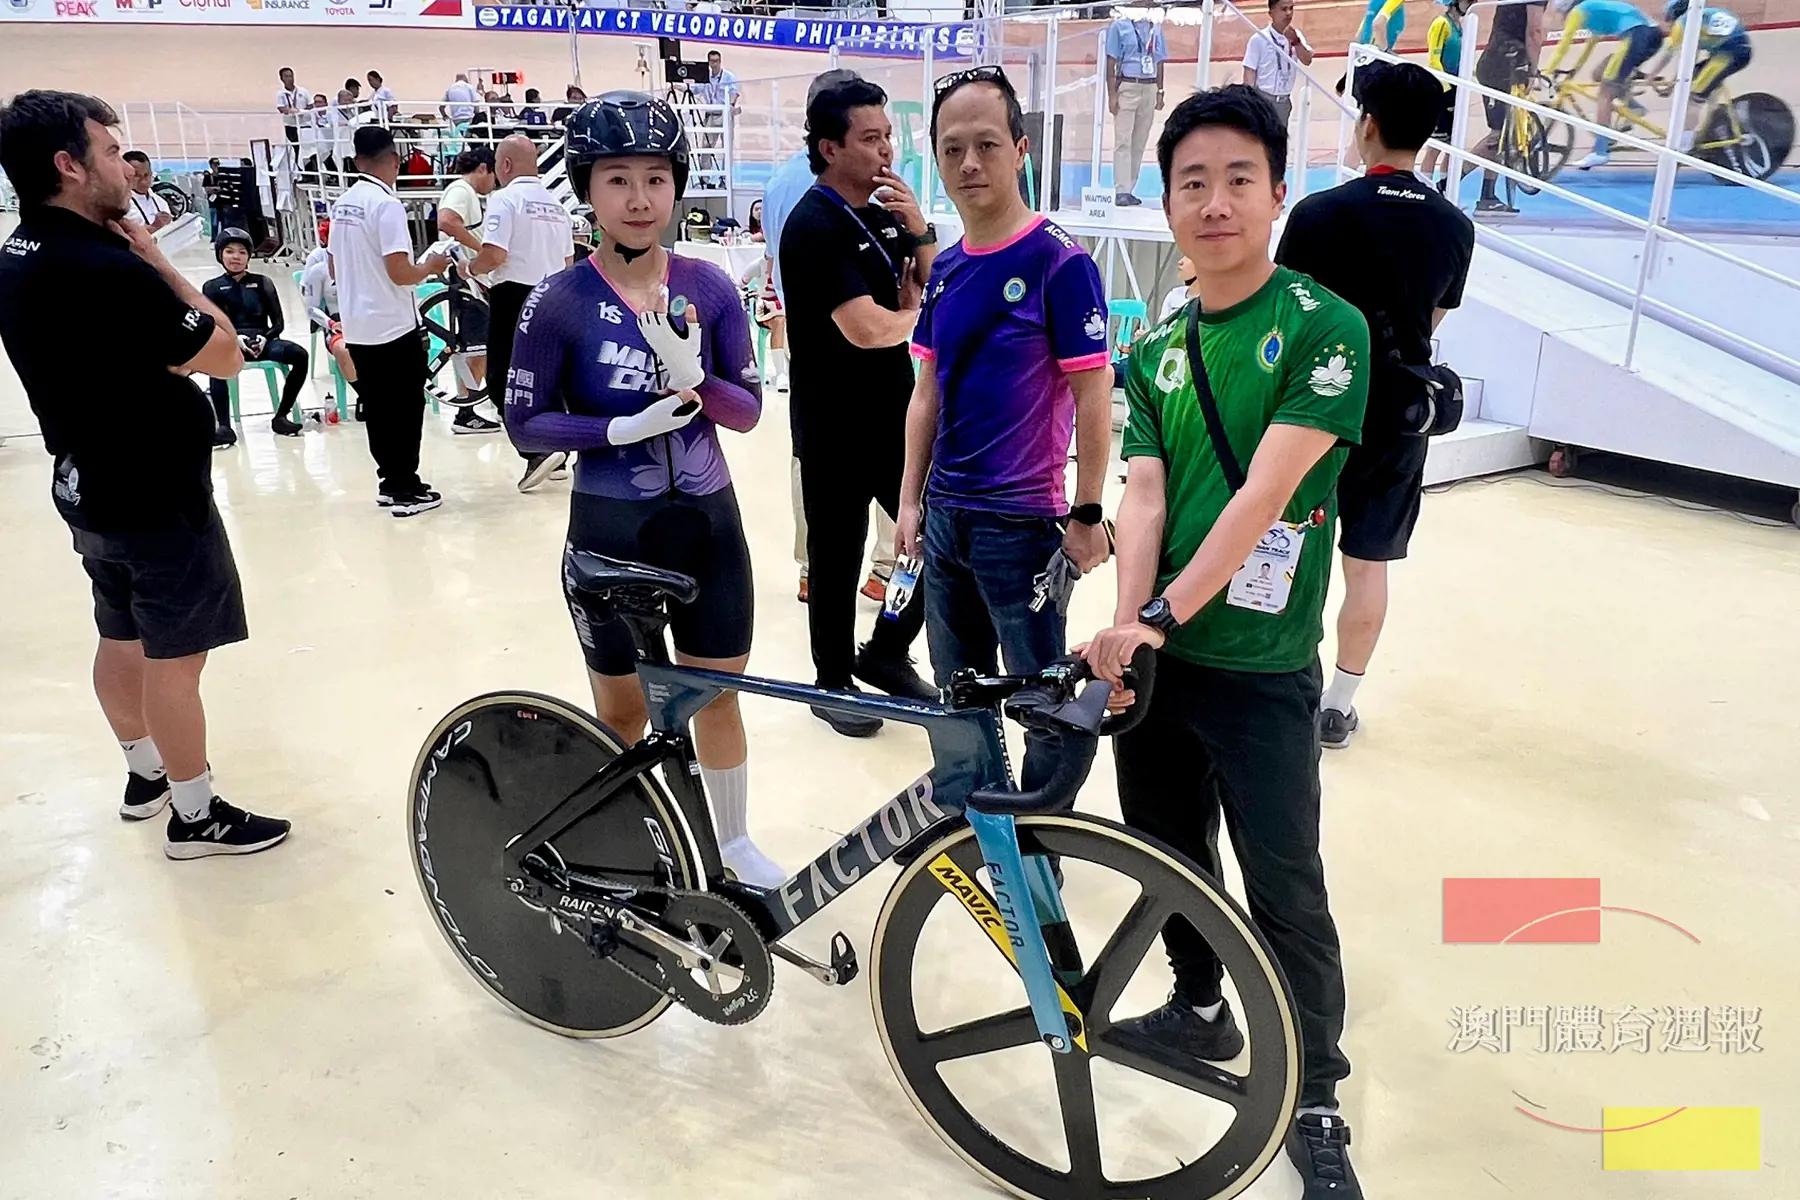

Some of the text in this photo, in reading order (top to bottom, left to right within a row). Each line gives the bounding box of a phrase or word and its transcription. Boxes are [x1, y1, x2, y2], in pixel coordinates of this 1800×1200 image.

[325, 7, 355, 16] TOYOTA
[500, 9, 606, 28] TAGAYAY
[616, 10, 641, 29] CT
[651, 13, 776, 41] VELODROME
[1084, 194, 1112, 204] WAITING
[1089, 209, 1106, 218] AREA
[1044, 224, 1075, 249] ACMC
[519, 281, 550, 335] ACMC
[780, 774, 946, 925] FACTOR
[935, 866, 1002, 929] MAVIC
[987, 862, 1025, 948] FACTOR
